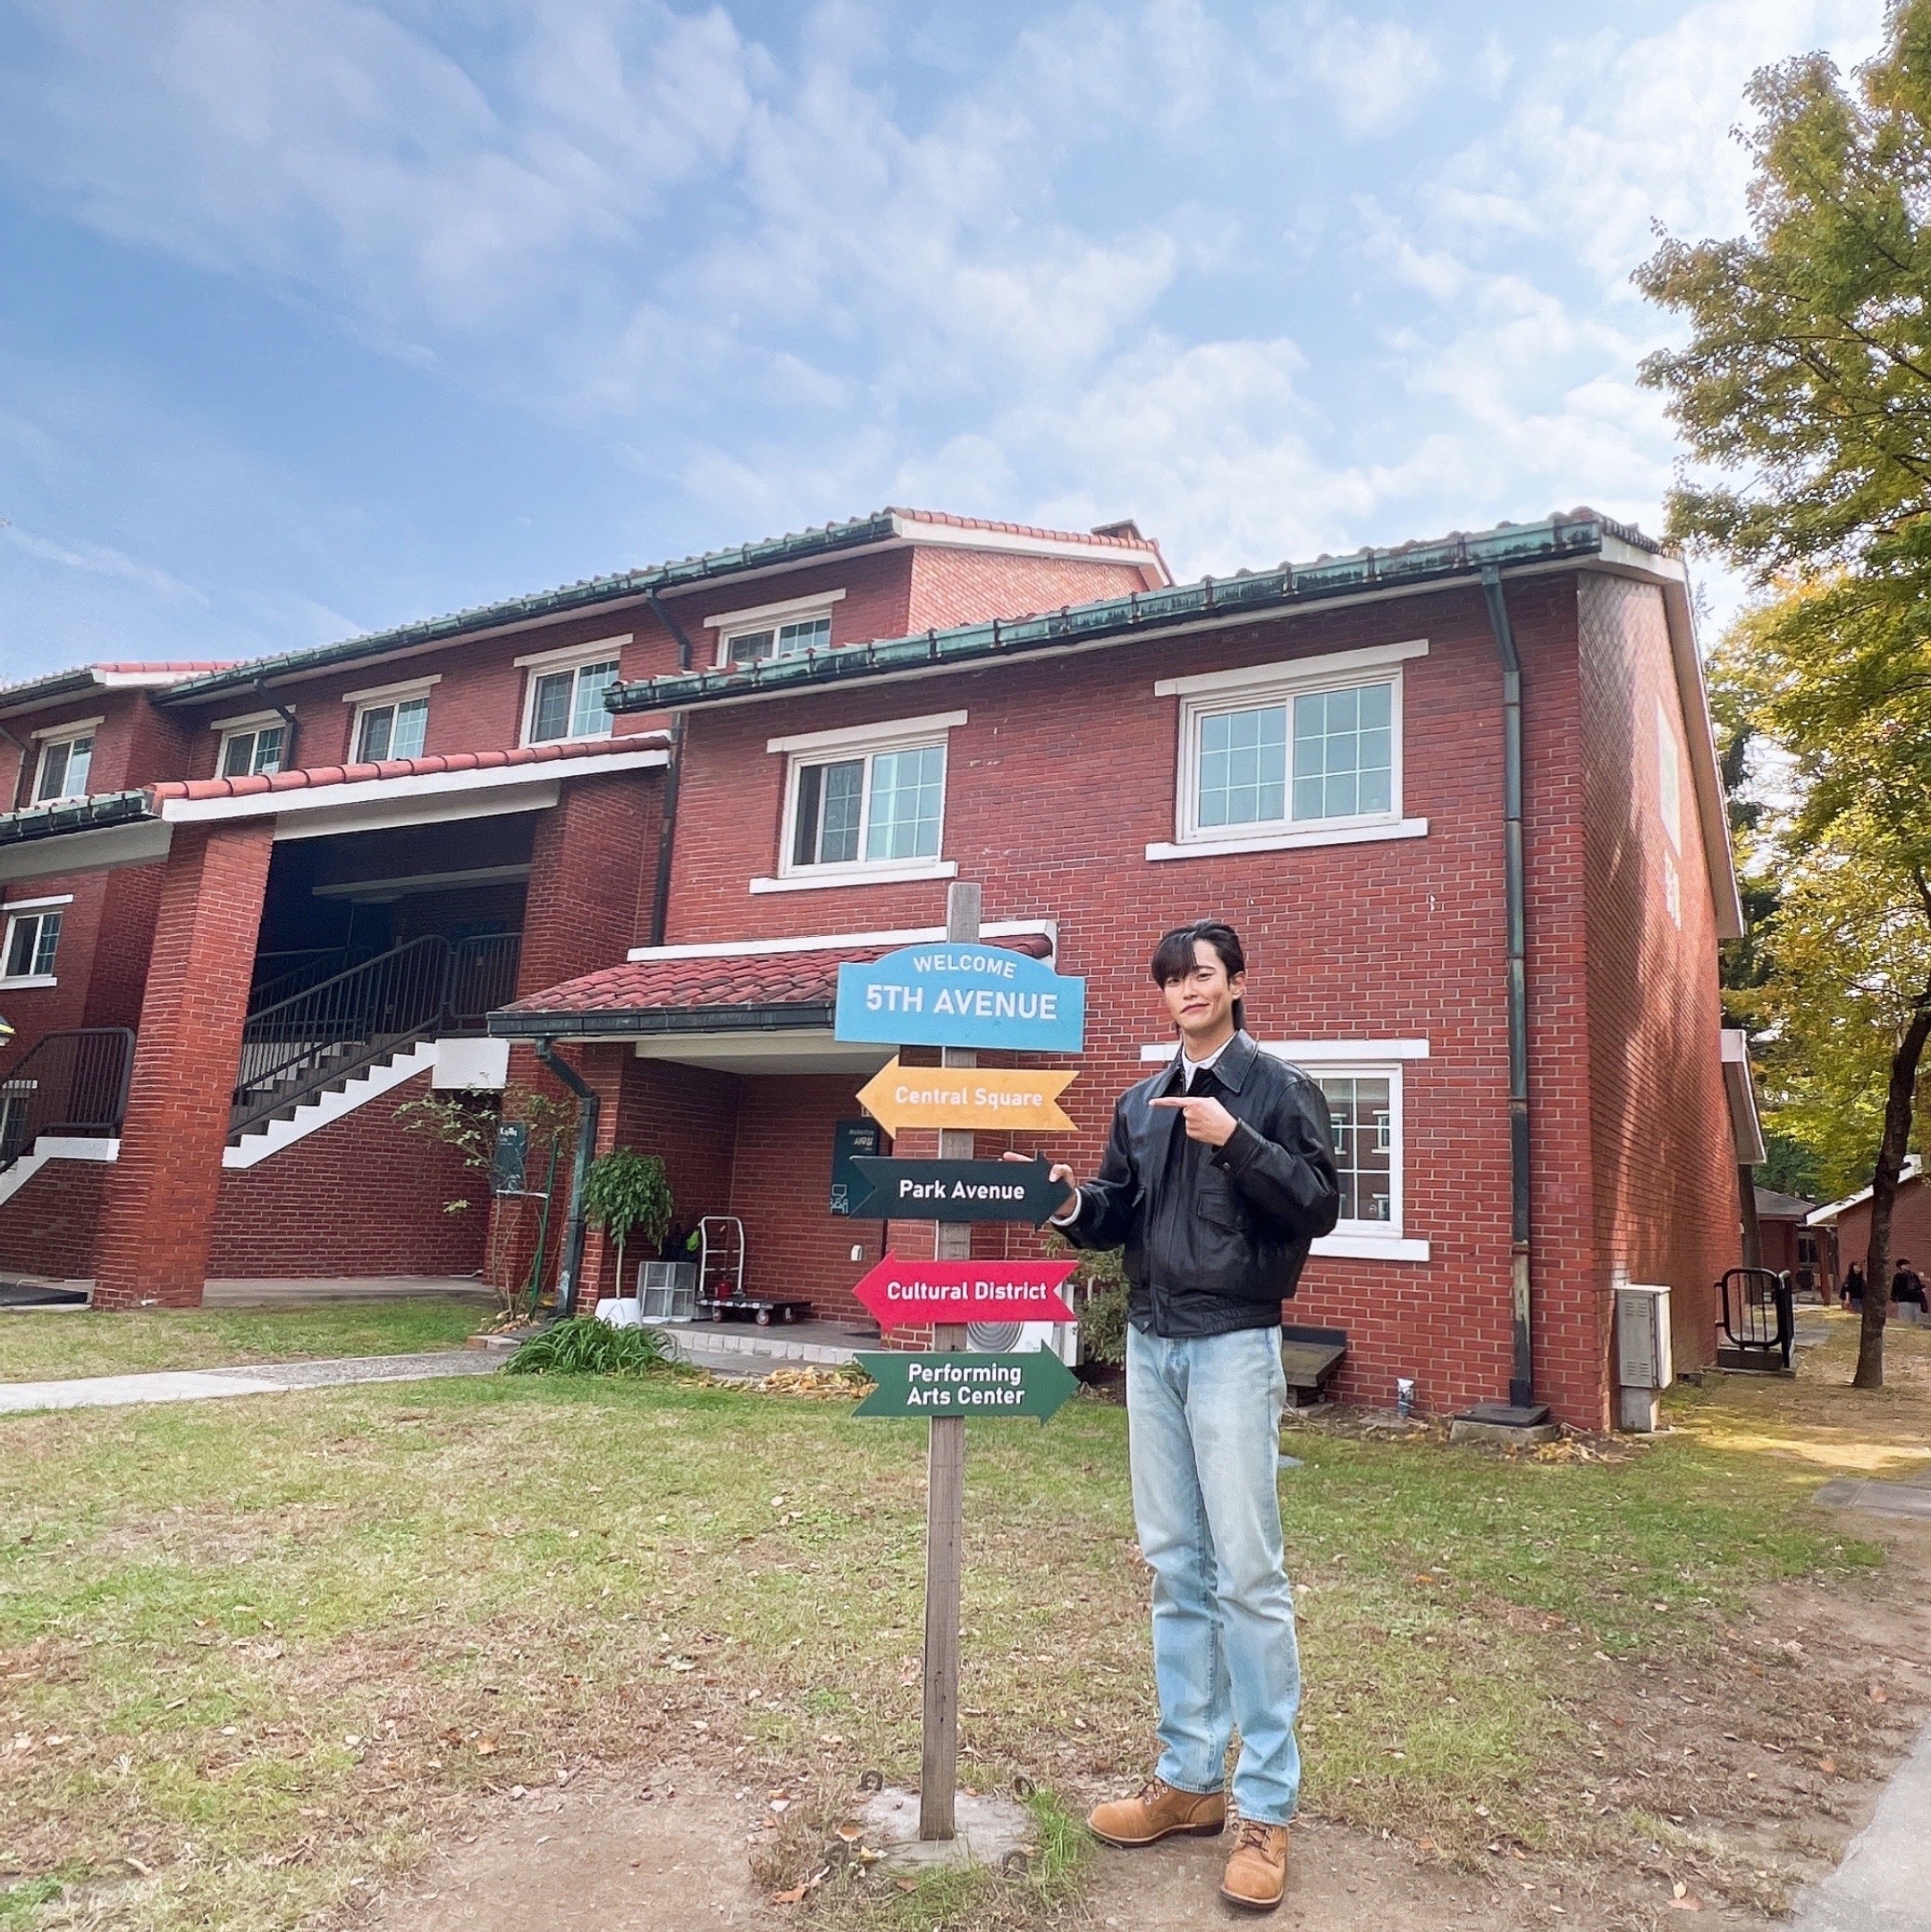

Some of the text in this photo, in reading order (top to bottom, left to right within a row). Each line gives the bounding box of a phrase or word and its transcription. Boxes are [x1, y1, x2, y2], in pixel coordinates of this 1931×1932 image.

[913, 954, 1017, 978] WELCOME
[866, 984, 1058, 1019] 5TH AVENUE
[895, 1086, 1042, 1110] Central Square
[899, 1179, 1025, 1200] Park Avenue
[887, 1281, 1047, 1301] Cultural District
[908, 1363, 1022, 1386] Performing
[906, 1386, 1025, 1405] Arts Center
